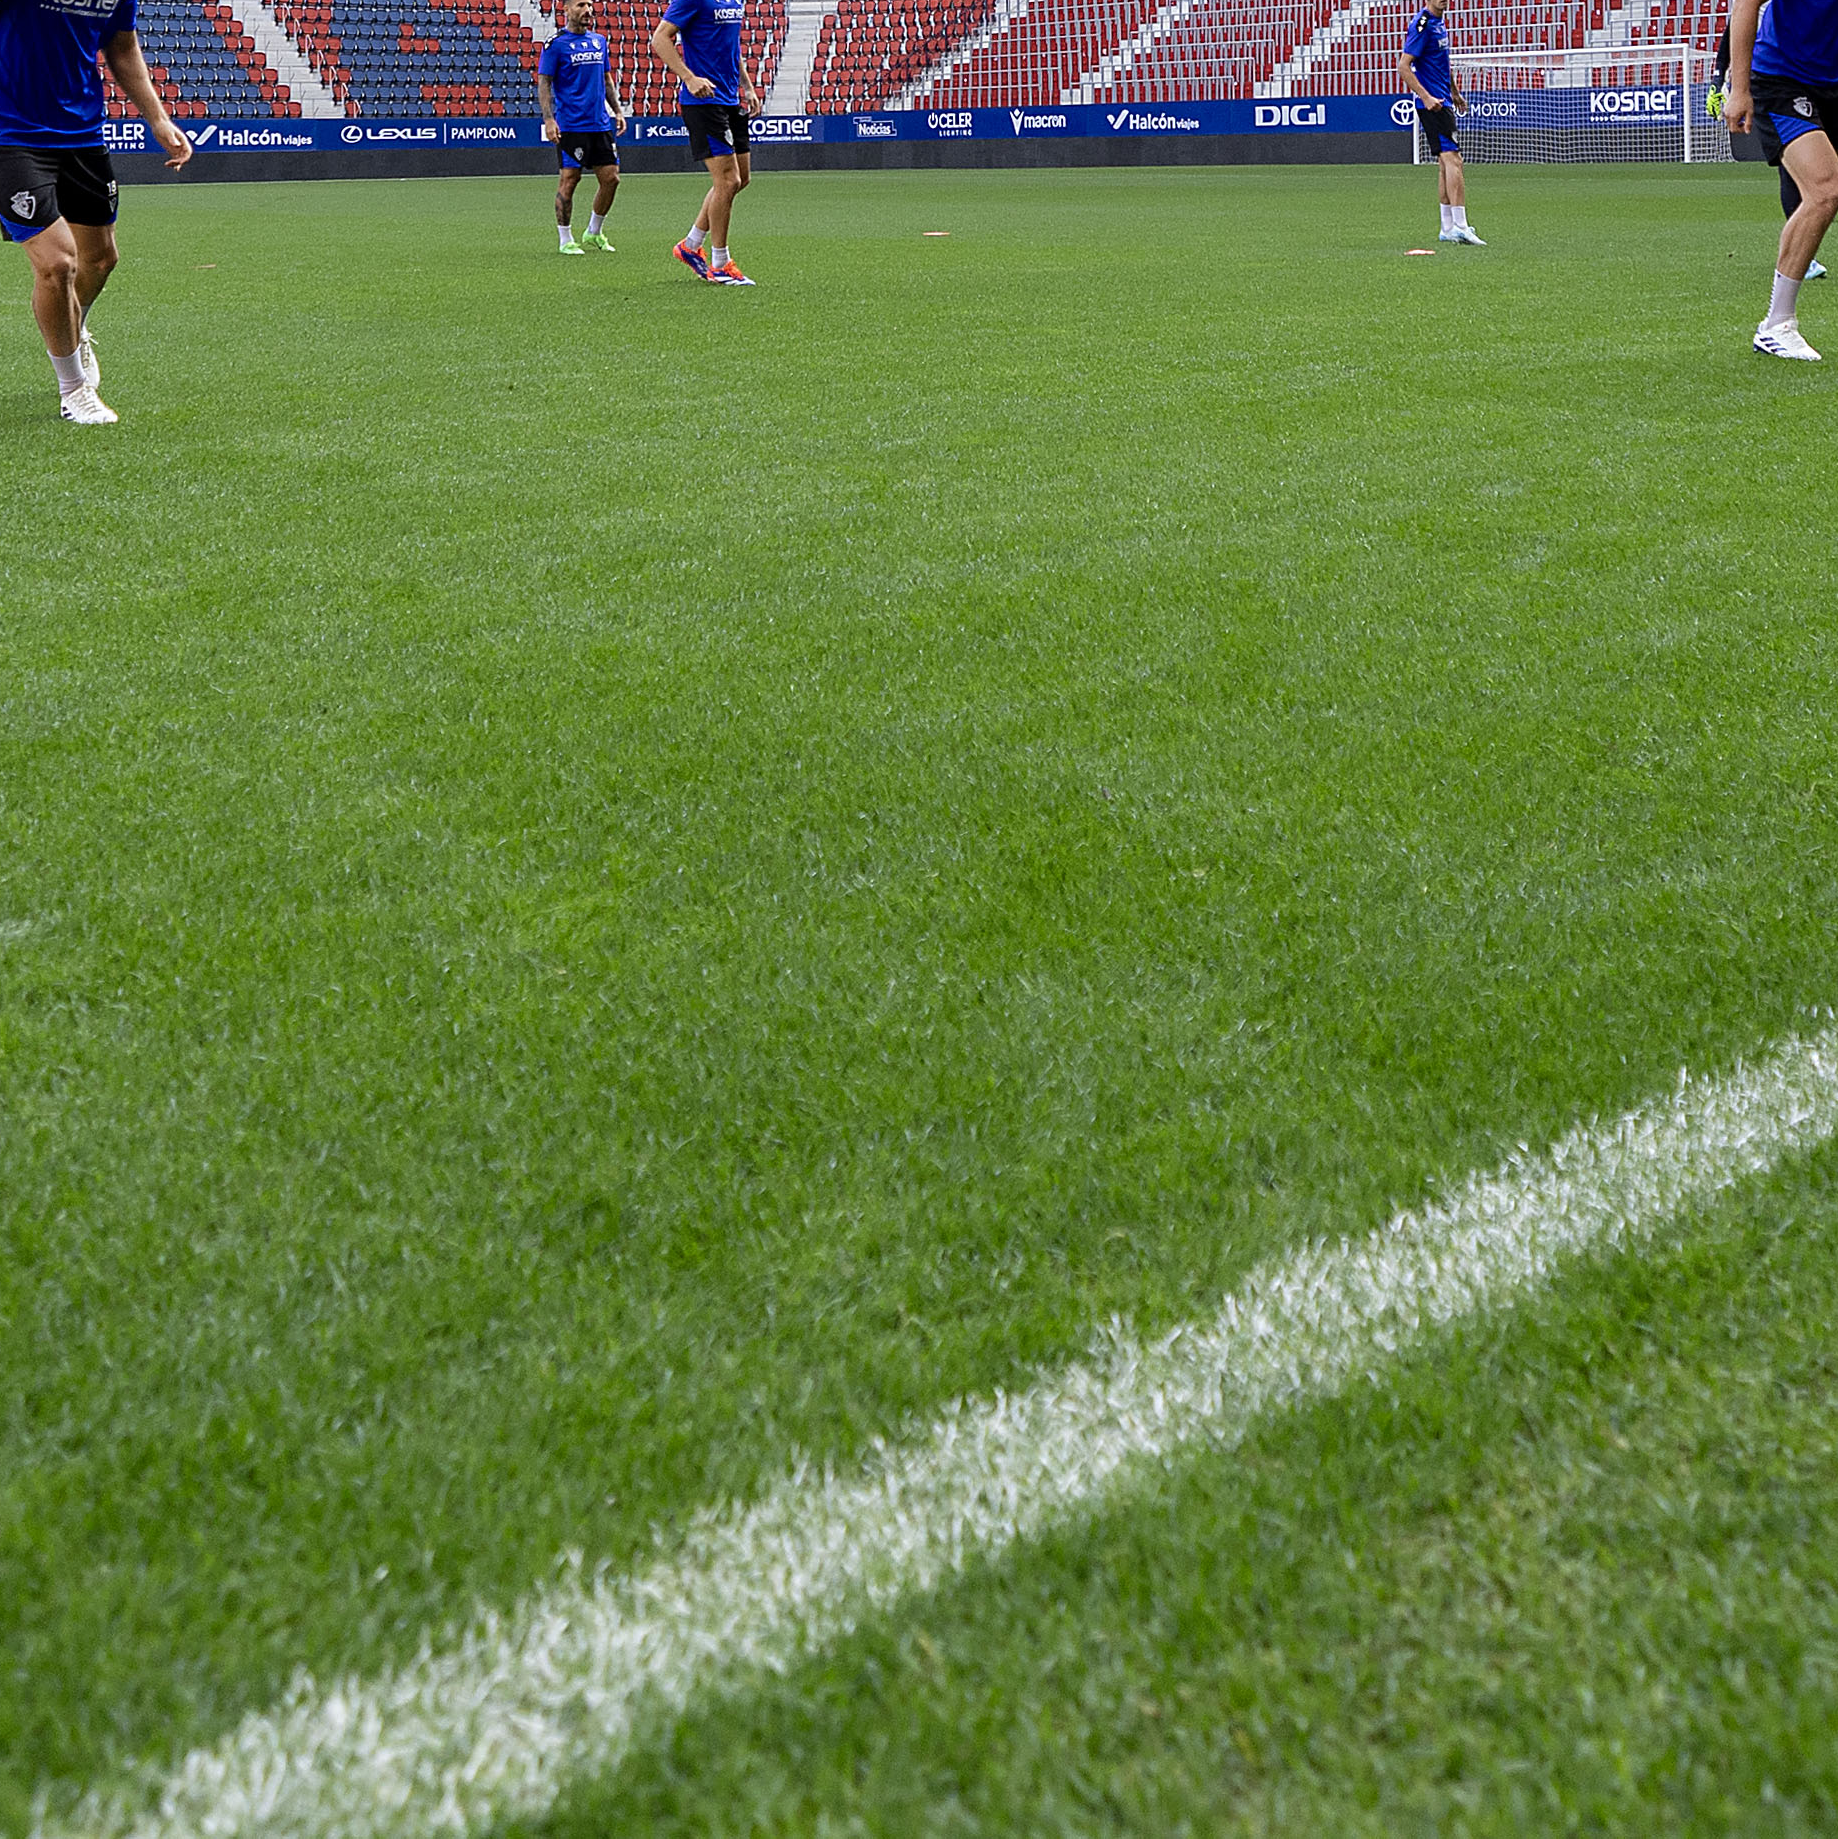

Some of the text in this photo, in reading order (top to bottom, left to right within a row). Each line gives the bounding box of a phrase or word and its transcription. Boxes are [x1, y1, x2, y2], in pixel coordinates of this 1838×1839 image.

[1255, 104, 1326, 127] DIGI
[1470, 102, 1518, 118] MOTOR
[939, 113, 973, 129] CELER
[1024, 113, 1066, 128] macron
[1129, 111, 1200, 131] Halcón viajes
[365, 127, 437, 141] LEXUS
[451, 127, 517, 140] PAMPLONA
[859, 122, 892, 136] Noticias
[218, 128, 313, 147] Halcón viajes
